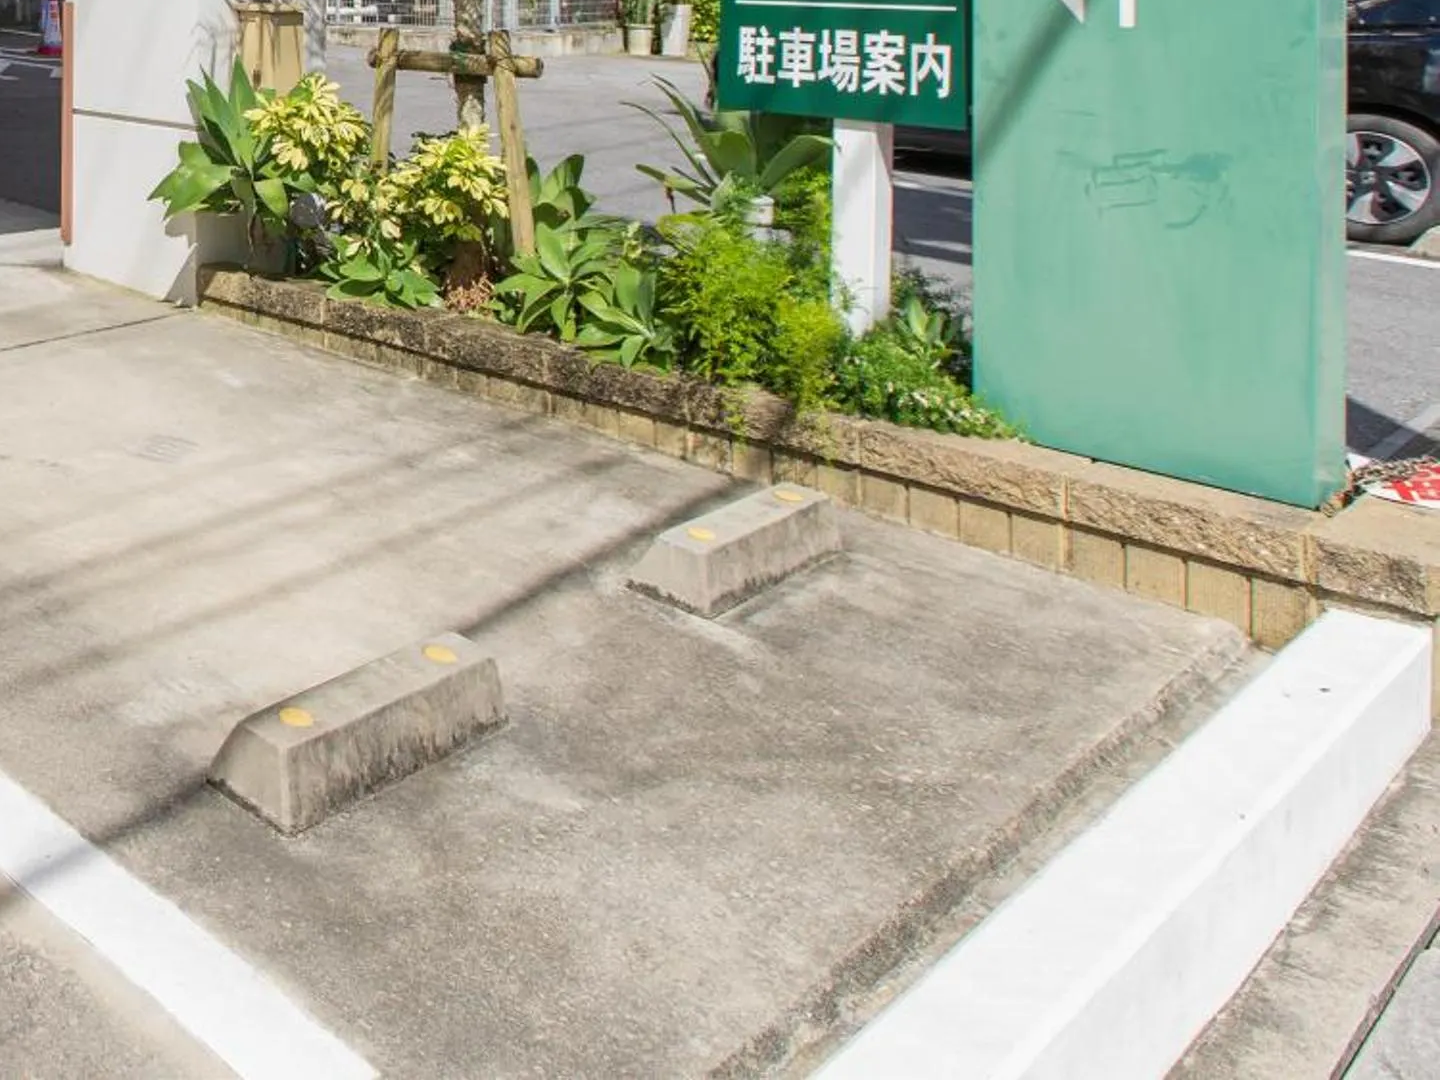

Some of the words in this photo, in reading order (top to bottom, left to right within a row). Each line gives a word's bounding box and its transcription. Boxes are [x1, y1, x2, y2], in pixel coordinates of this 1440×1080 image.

[737, 25, 952, 99] 駐車場案内
